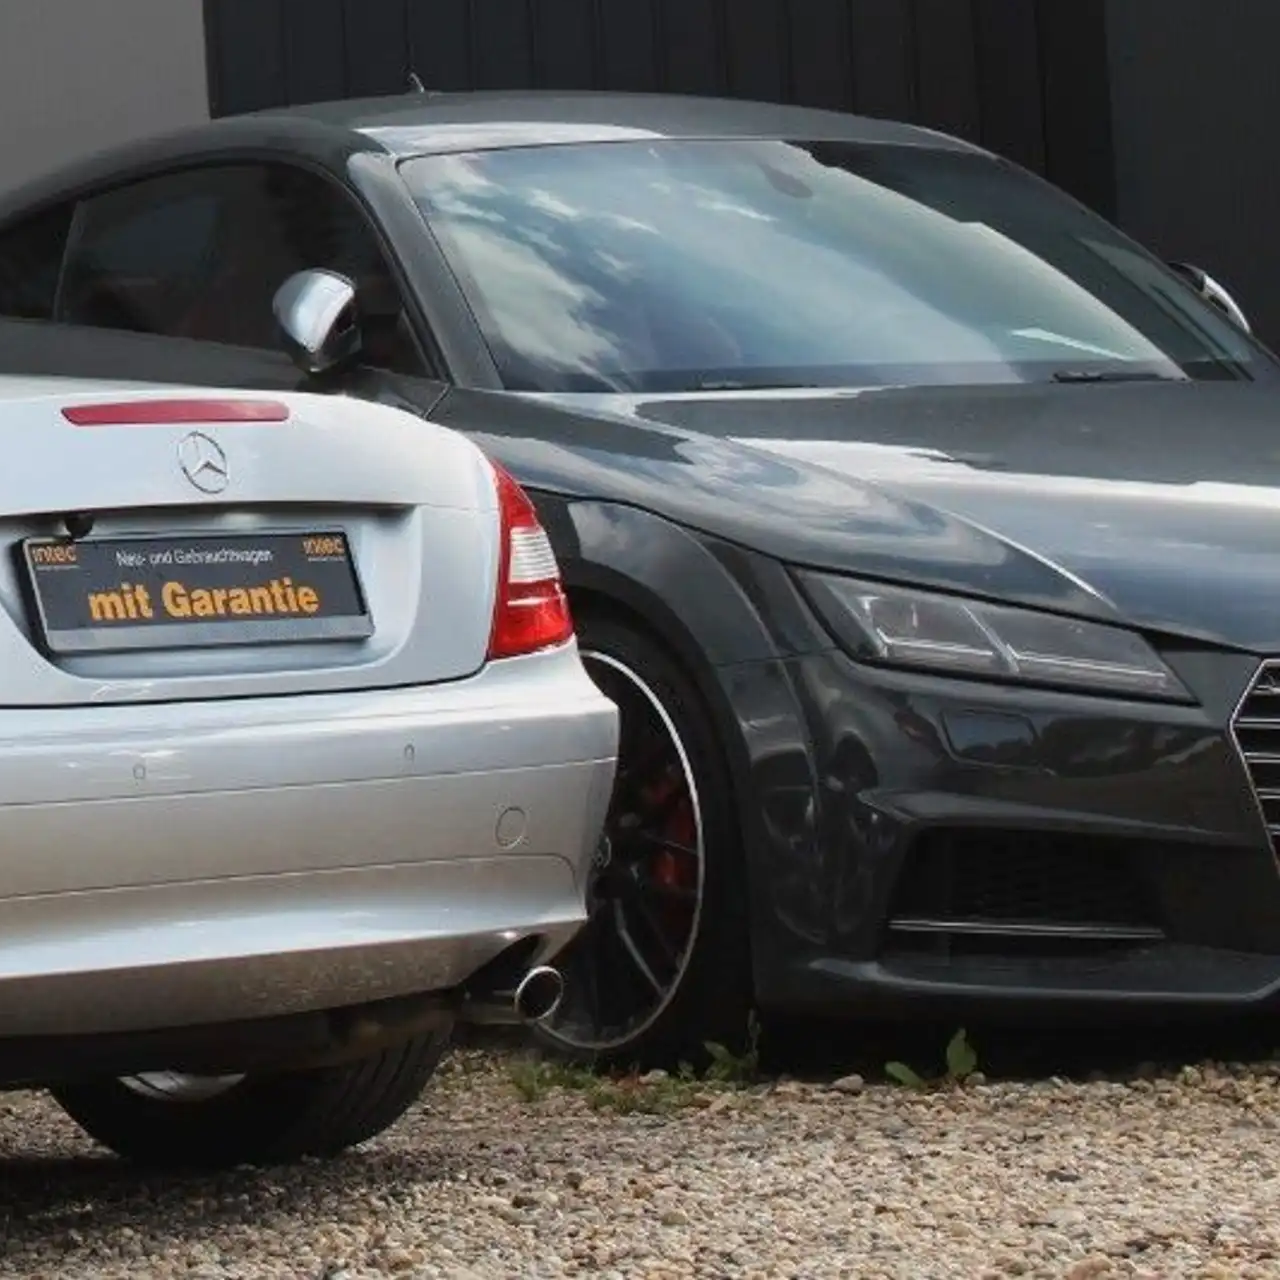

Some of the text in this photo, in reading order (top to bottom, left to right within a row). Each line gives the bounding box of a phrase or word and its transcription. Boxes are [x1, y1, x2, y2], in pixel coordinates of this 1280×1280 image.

[148, 548, 173, 565] und
[174, 545, 274, 567] Gebrauchtwagen
[87, 577, 320, 622] mit Garantie
